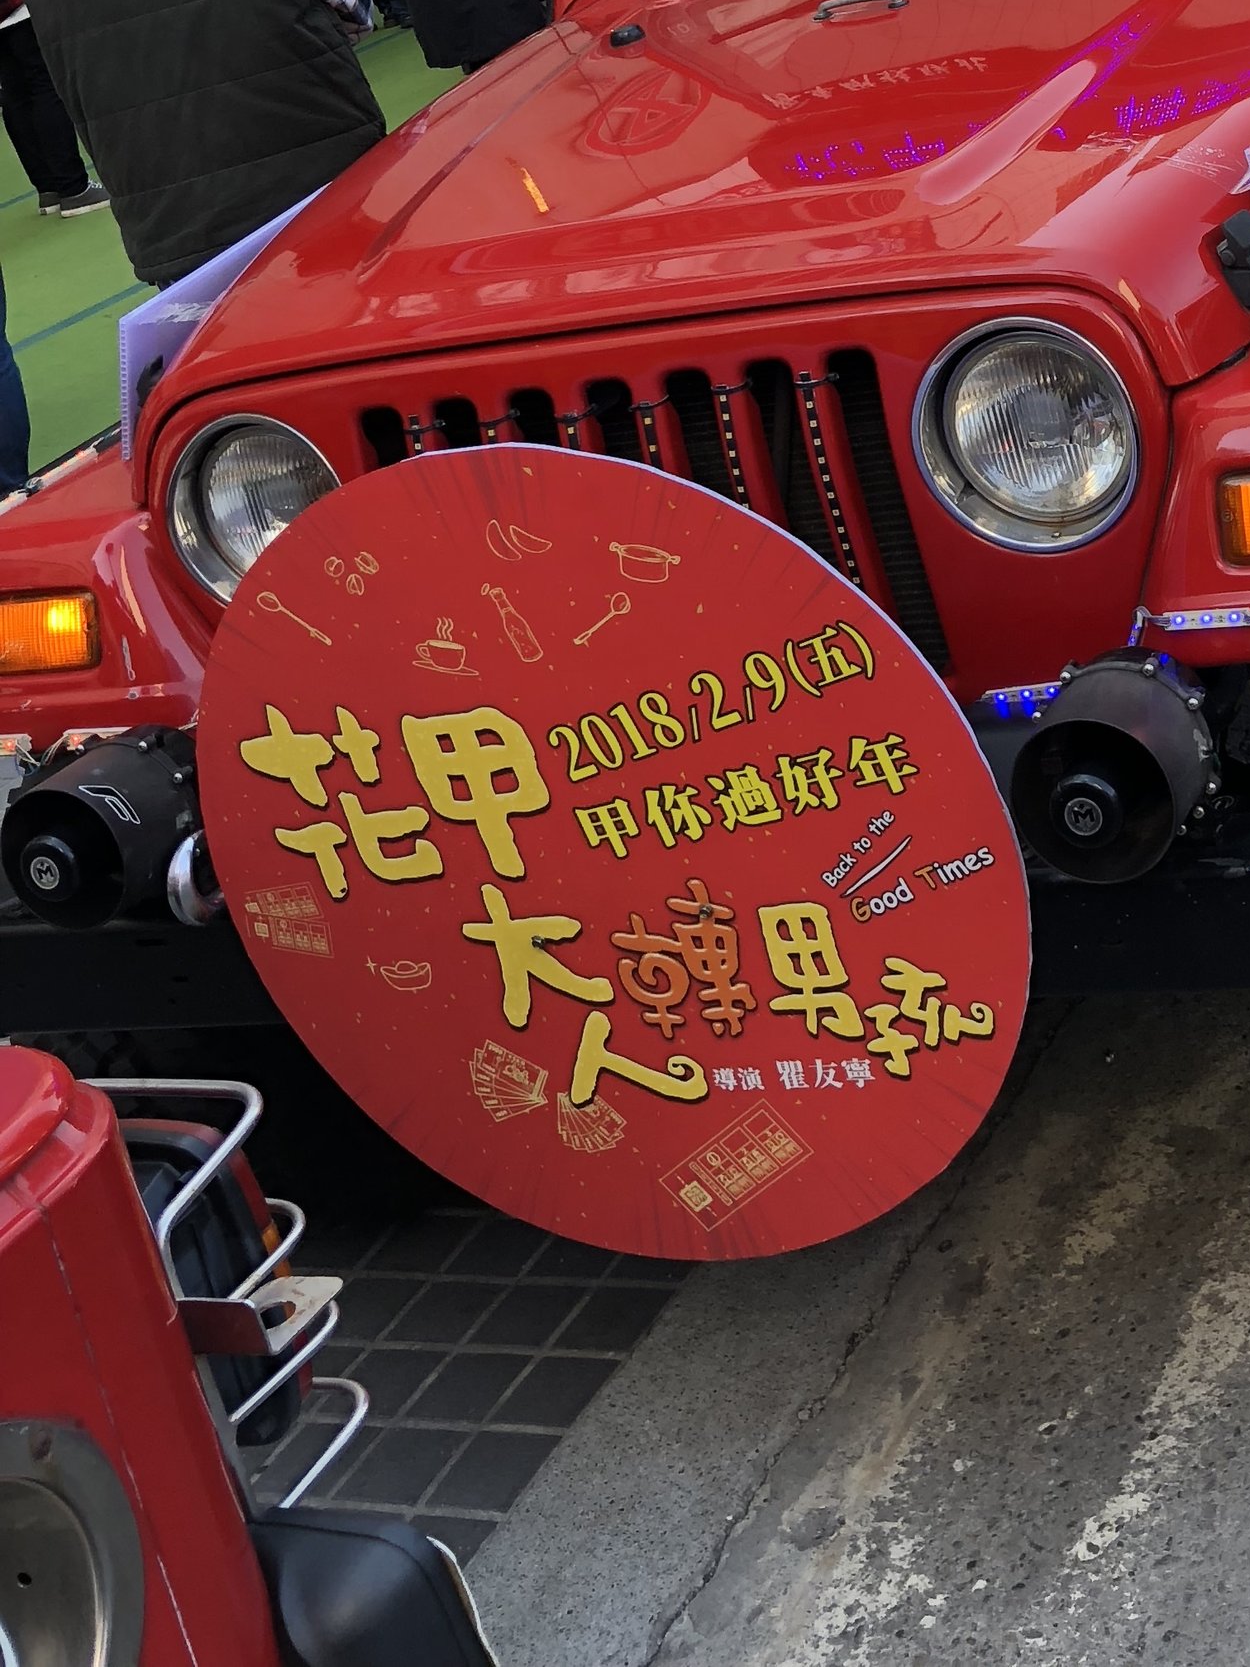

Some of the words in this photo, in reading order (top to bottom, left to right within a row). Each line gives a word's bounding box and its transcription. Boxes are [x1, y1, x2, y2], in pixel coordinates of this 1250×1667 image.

[547, 619, 876, 785] 2018/2/9(五)
[238, 701, 555, 903] 花甲
[572, 733, 920, 860] 甲你過好年
[822, 852, 858, 888] Back
[852, 835, 872, 855] to
[867, 810, 896, 836] the
[850, 877, 915, 922] Good
[913, 847, 996, 890] Times
[712, 1066, 767, 1094] 導演
